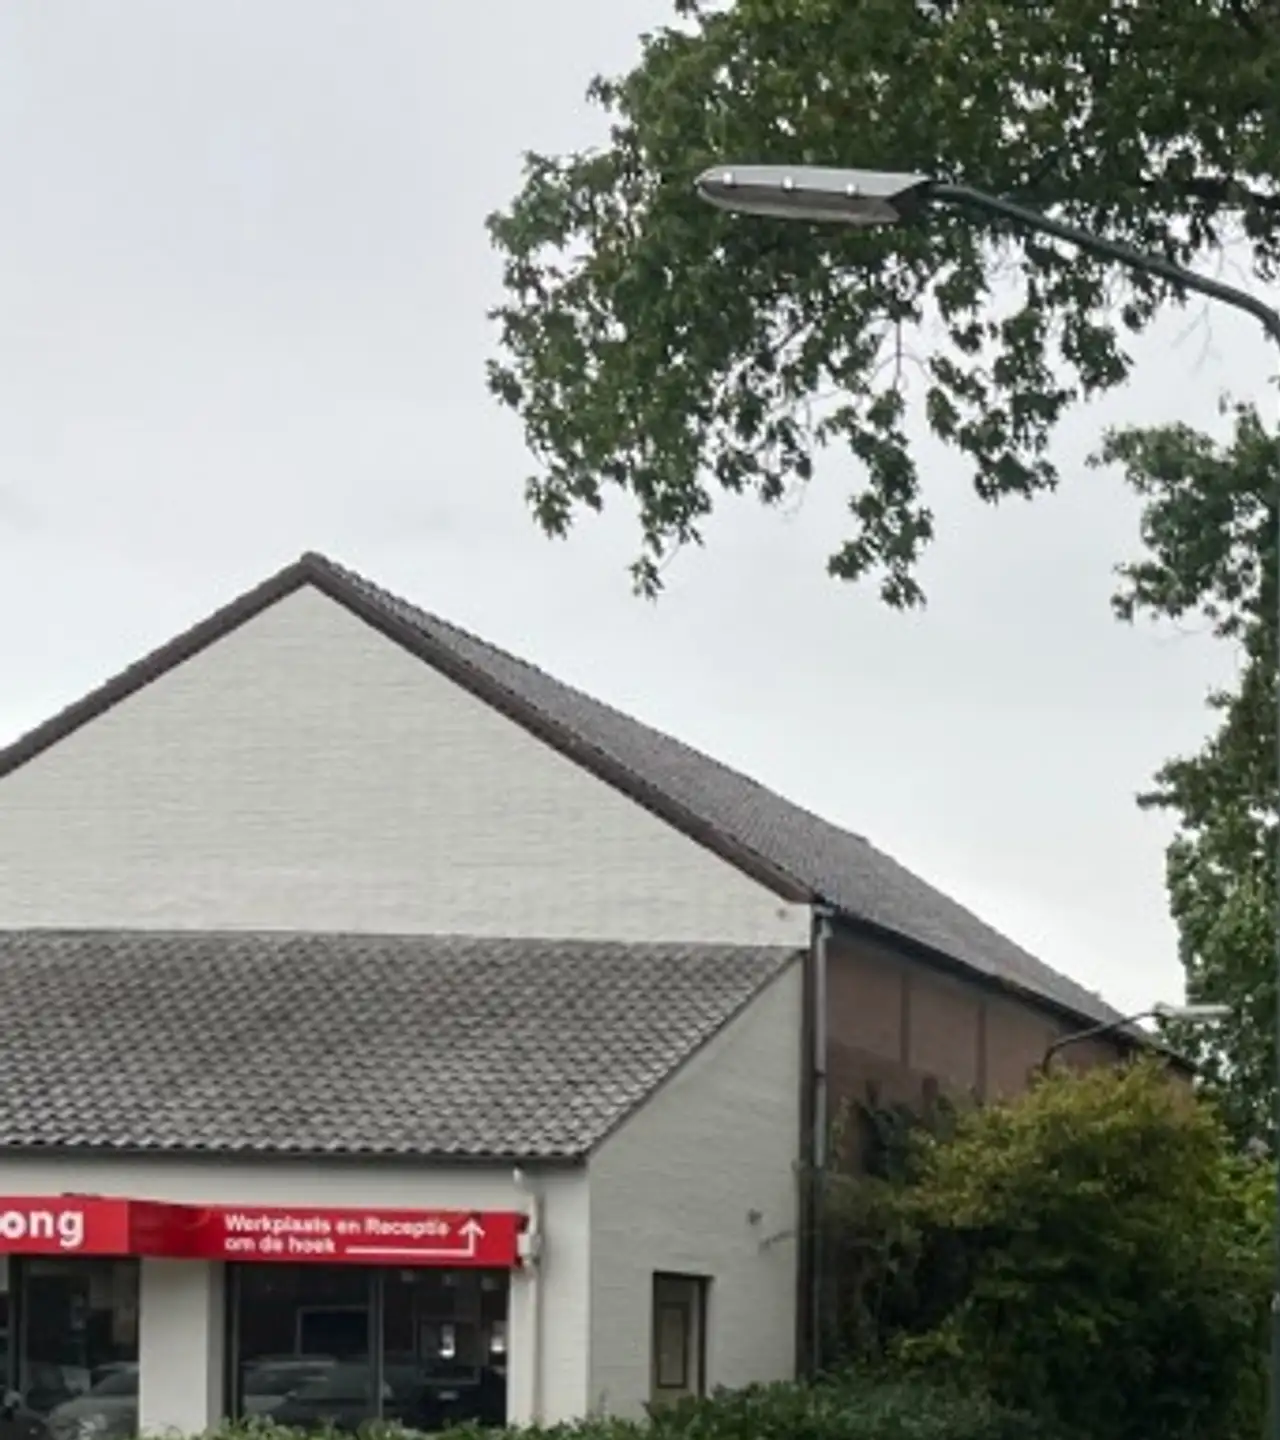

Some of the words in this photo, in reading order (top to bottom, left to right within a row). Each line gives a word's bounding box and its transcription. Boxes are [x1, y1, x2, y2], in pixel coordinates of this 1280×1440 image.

[224, 1213, 331, 1236] Werkplaats
[336, 1217, 361, 1235] en
[365, 1217, 450, 1238] Receptie
[224, 1238, 256, 1251] om
[259, 1235, 284, 1252] de
[288, 1236, 336, 1255] hoek
